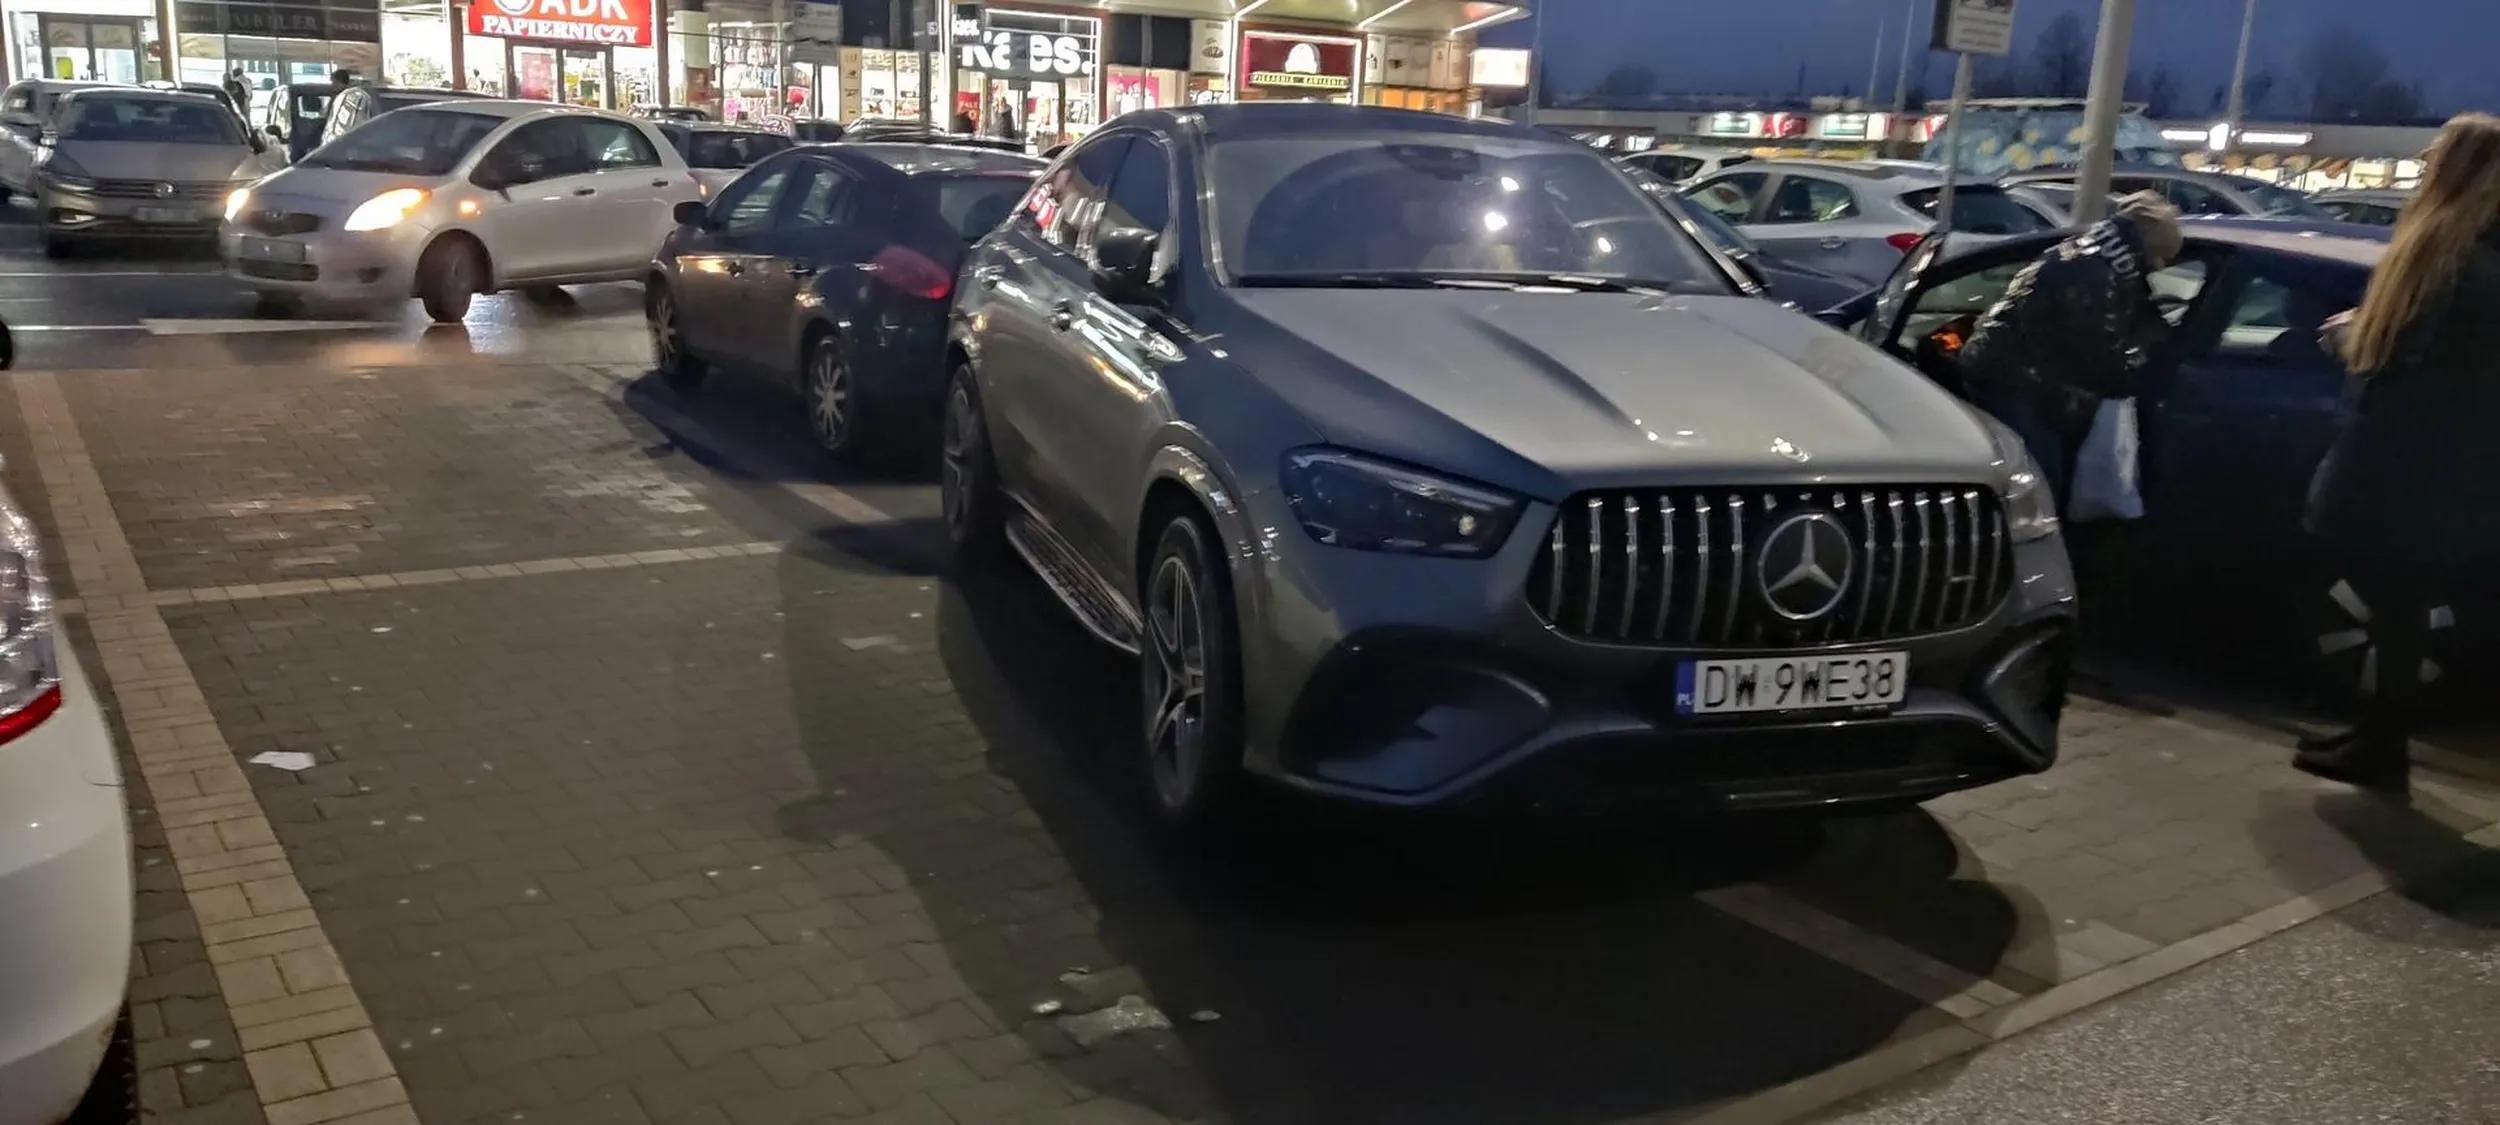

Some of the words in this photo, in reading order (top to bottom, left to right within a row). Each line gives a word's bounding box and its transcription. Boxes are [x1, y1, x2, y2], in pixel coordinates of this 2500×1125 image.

[481, 15, 639, 44] PAPIERNICZY
[1704, 664, 1759, 708] DW
[1775, 658, 1896, 704] 9WE38
[1677, 692, 1692, 706] PL
